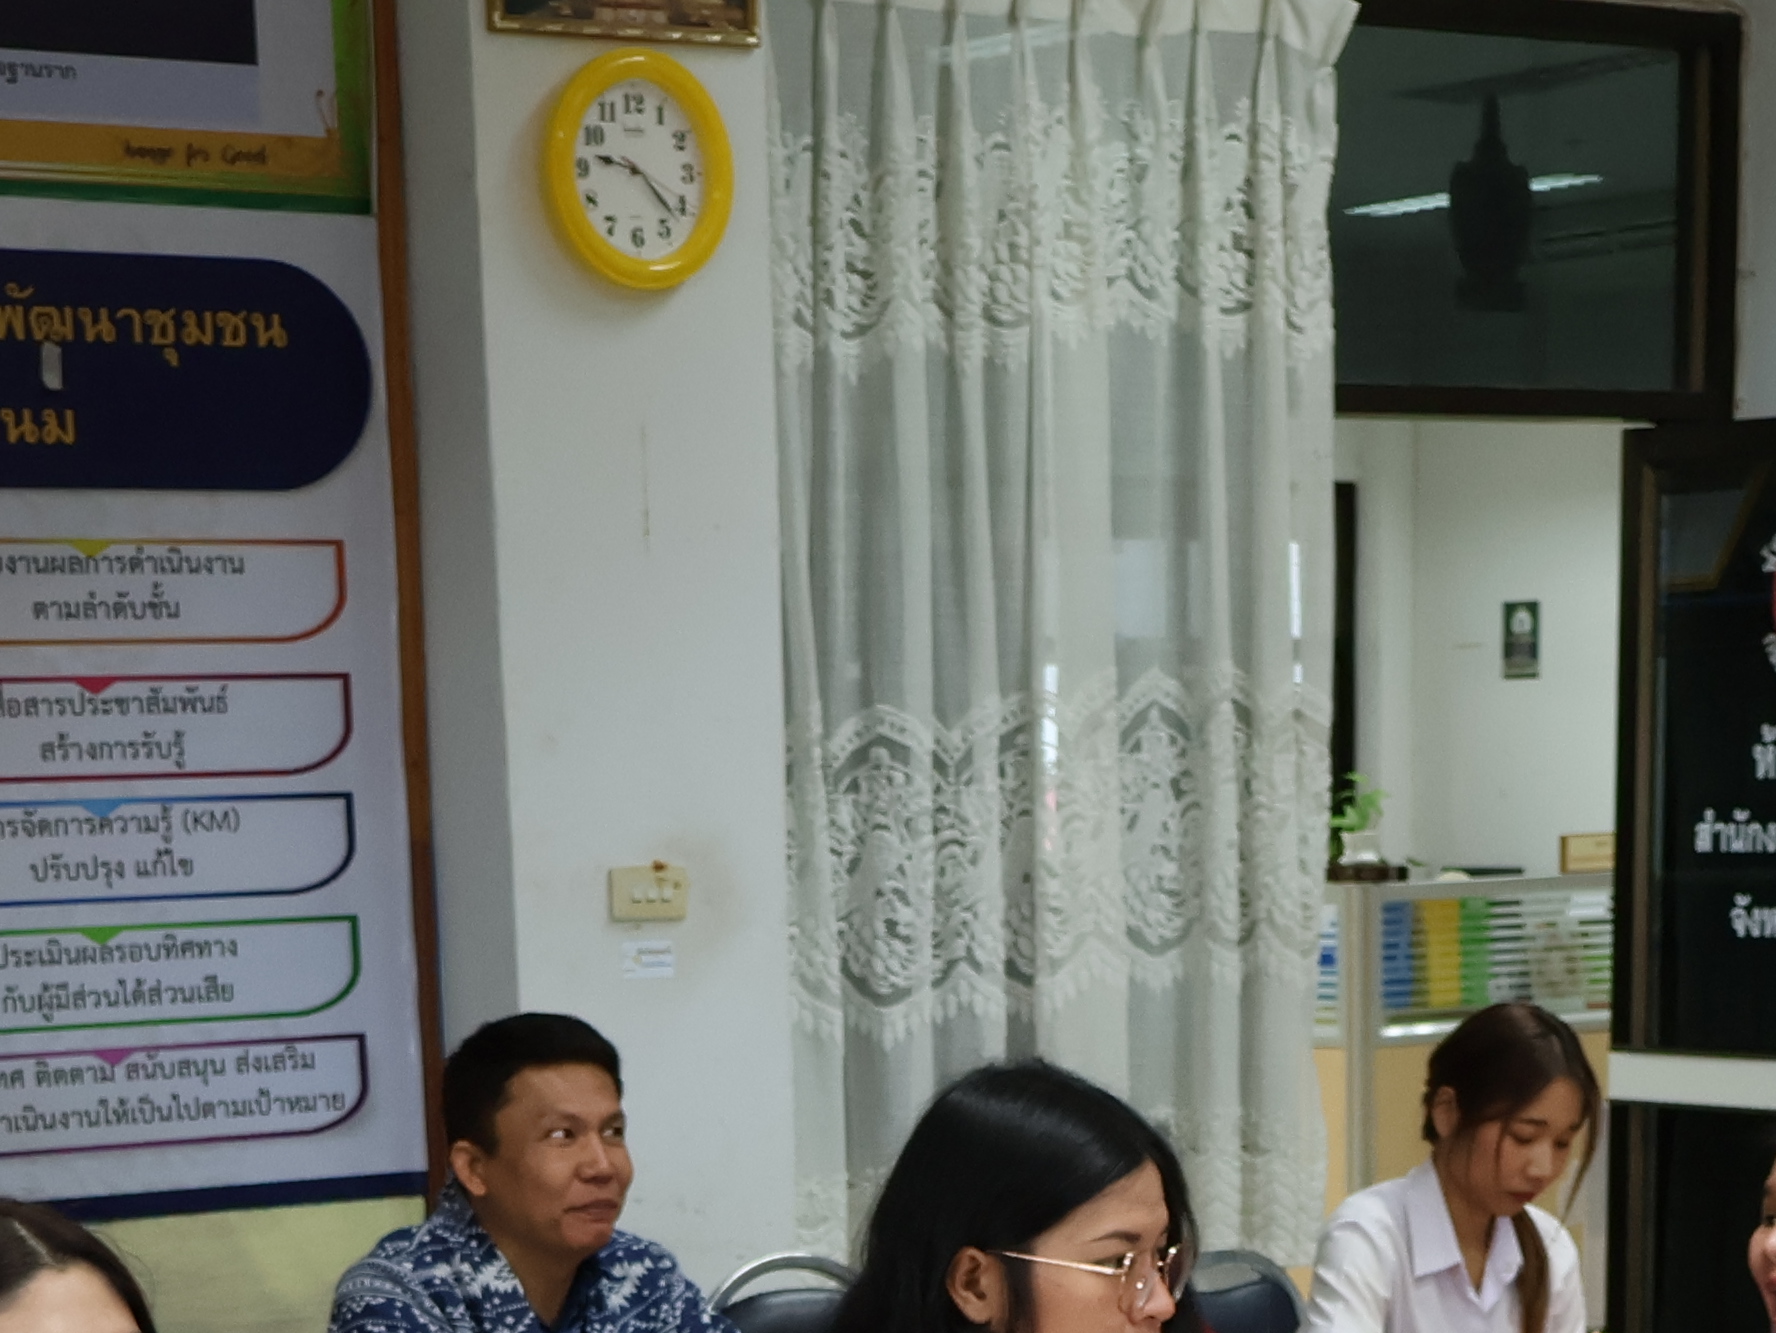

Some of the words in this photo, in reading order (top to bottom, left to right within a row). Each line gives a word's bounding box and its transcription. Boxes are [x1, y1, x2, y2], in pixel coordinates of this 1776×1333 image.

[597, 101, 616, 123] 11
[584, 125, 604, 147] 10
[39, 731, 187, 769] สร้างการรับรู้
[182, 809, 241, 836] (KM)
[30, 851, 126, 888] ปรับปรุง
[136, 848, 194, 880] แก้ไข
[1, 980, 235, 1024] กับผู้มีส่วนได้ส่วนเสีย
[125, 1056, 227, 1089] สนับสนุน
